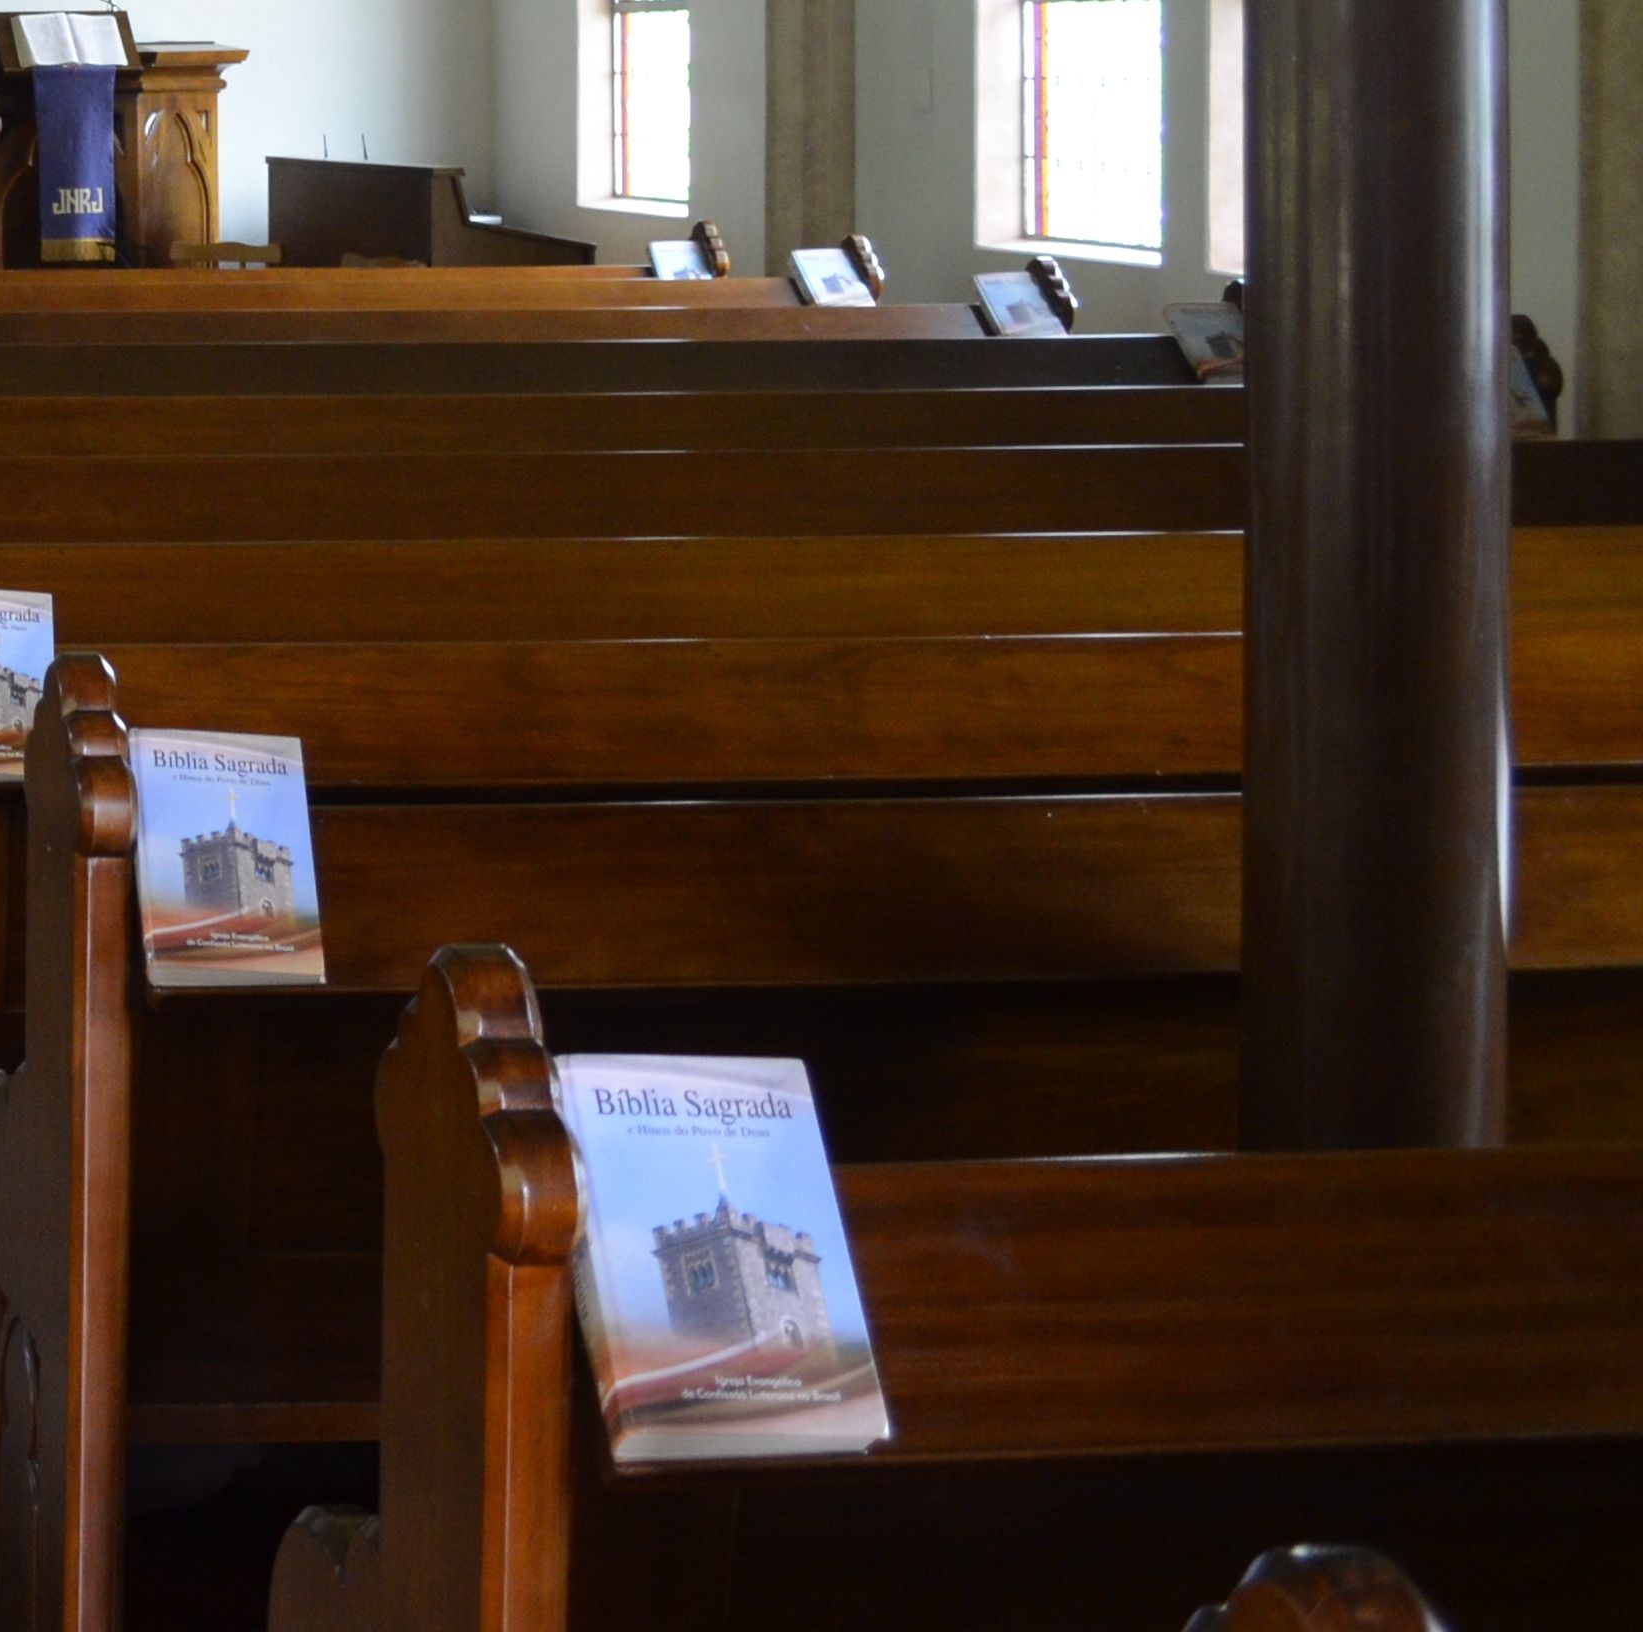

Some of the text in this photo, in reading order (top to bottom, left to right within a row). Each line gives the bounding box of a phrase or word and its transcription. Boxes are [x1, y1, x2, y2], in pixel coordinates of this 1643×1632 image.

[214, 754, 288, 777] Sagrada
[594, 1088, 793, 1126] Bíblia Sagrada
